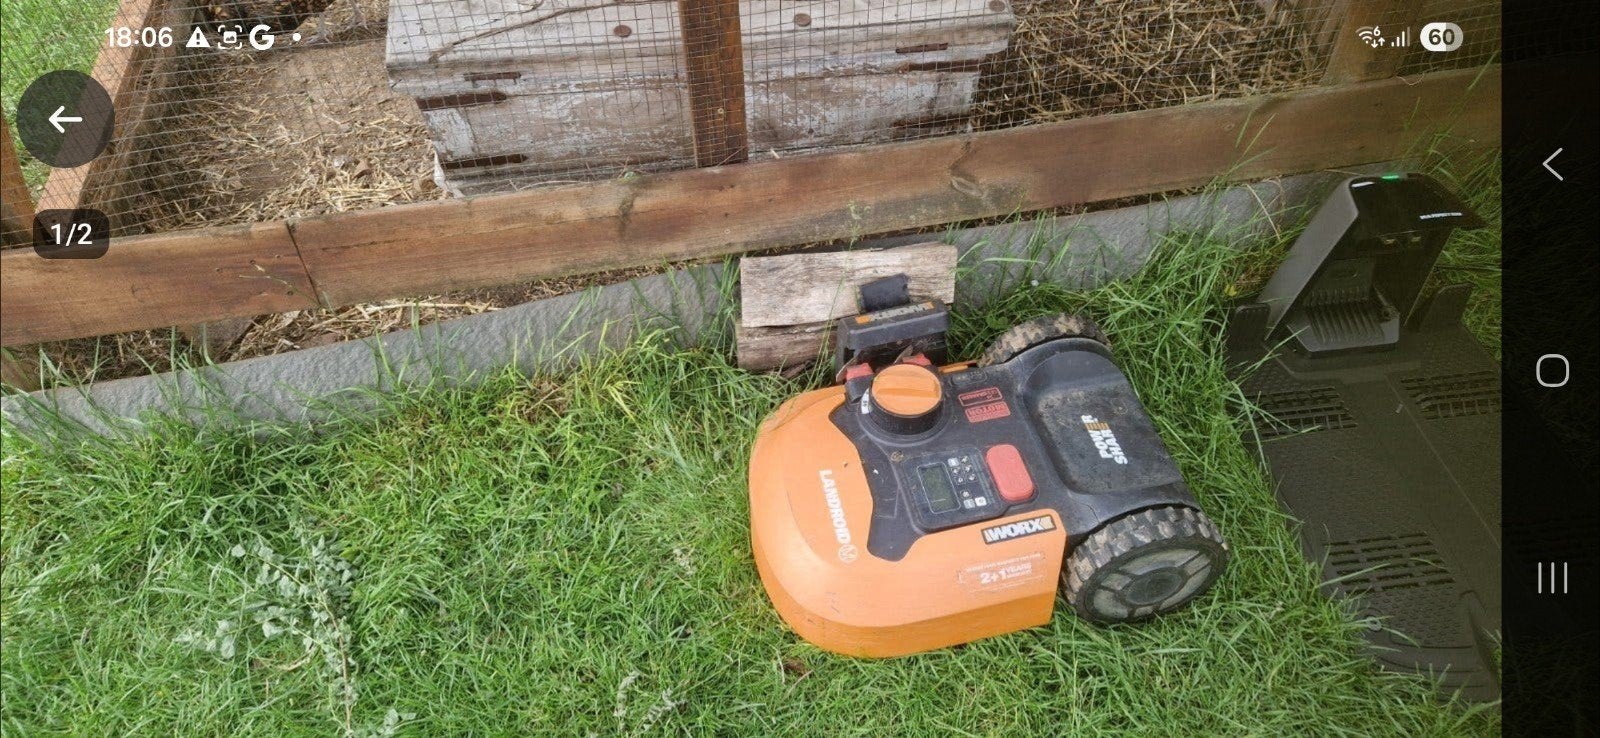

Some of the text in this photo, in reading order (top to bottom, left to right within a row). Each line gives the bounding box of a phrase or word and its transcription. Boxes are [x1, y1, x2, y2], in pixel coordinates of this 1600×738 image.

[1081, 415, 1113, 459] POWER
[1098, 422, 1129, 465] SHARE
[818, 468, 852, 546] LANDROID
[987, 517, 1046, 542] WORX
